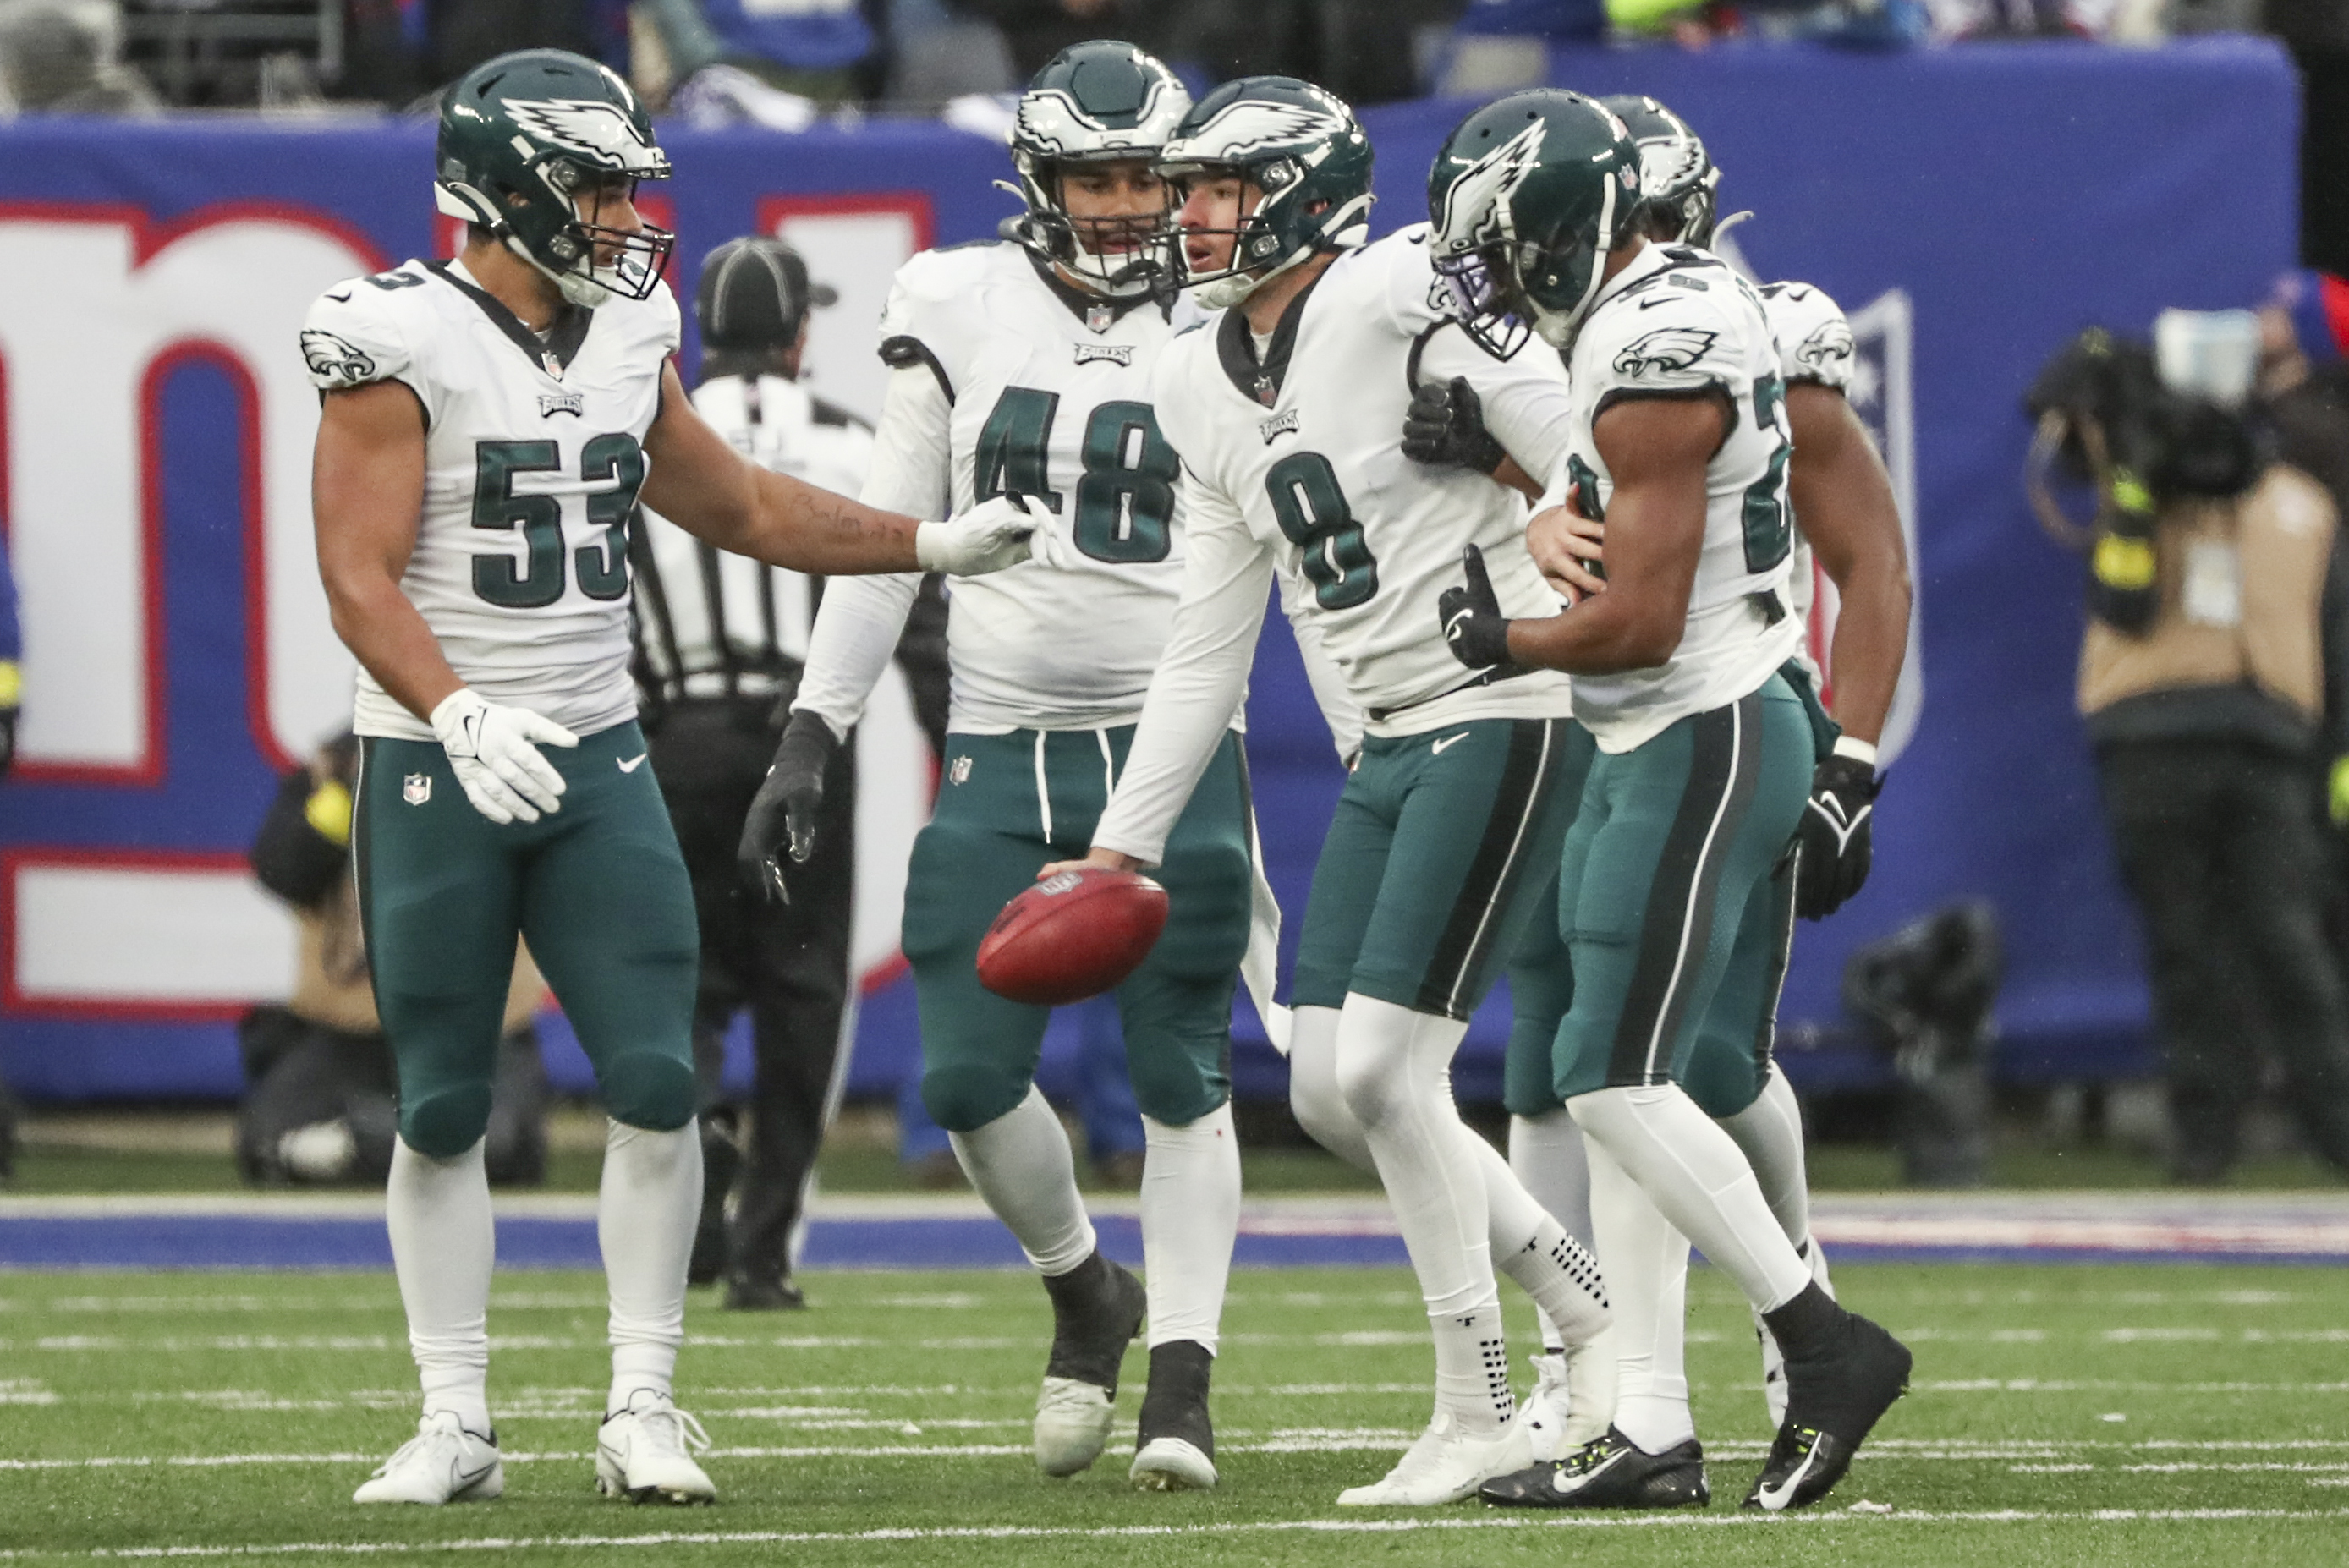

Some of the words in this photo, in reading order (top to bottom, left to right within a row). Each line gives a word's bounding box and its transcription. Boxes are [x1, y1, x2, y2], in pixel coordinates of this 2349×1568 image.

[1074, 343, 1136, 366] EAGLES
[471, 432, 645, 608] 53
[974, 385, 1181, 563] 48
[1265, 451, 1379, 610] 8
